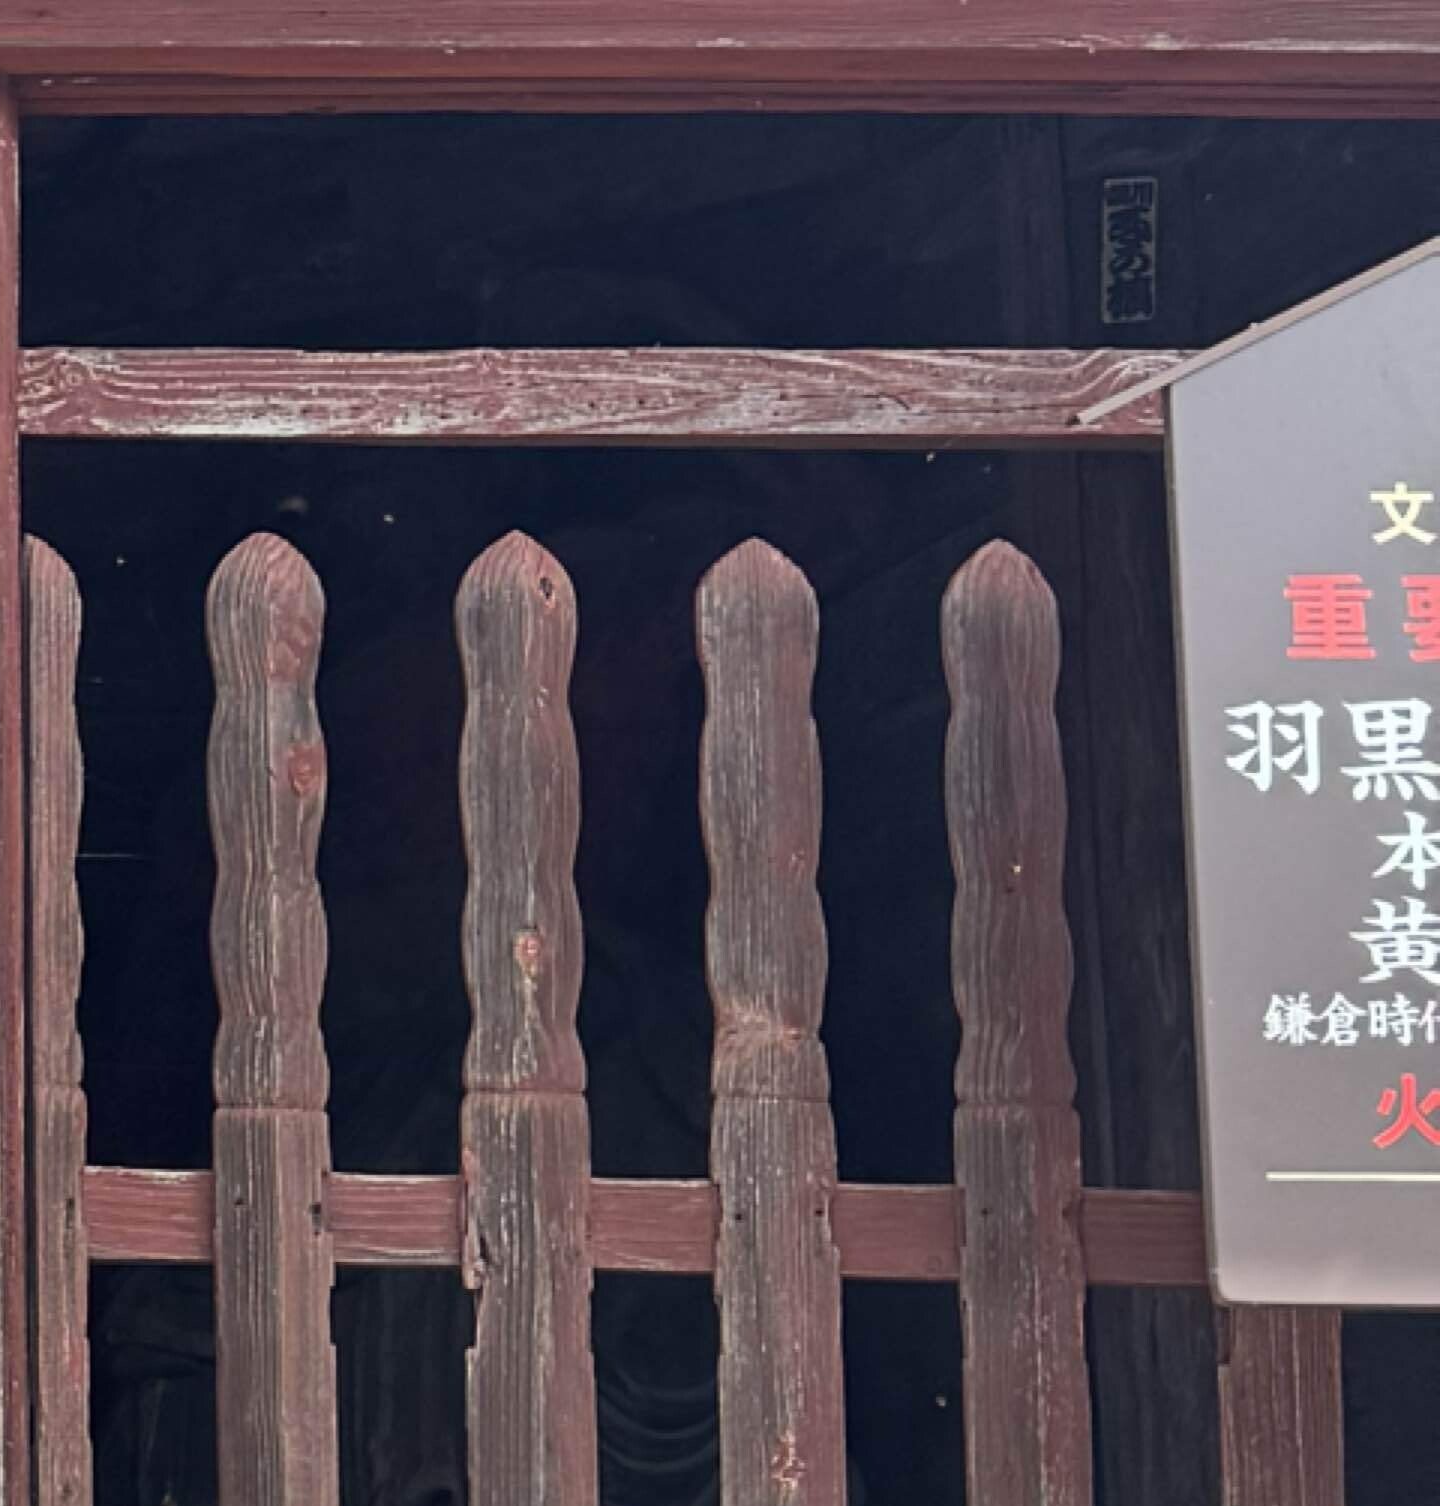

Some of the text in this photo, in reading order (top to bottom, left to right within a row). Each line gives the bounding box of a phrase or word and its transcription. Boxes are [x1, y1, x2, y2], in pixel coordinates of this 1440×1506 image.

[1371, 810, 1440, 891] 本
[1349, 896, 1440, 985] 黄
[1373, 1072, 1440, 1150] 火
